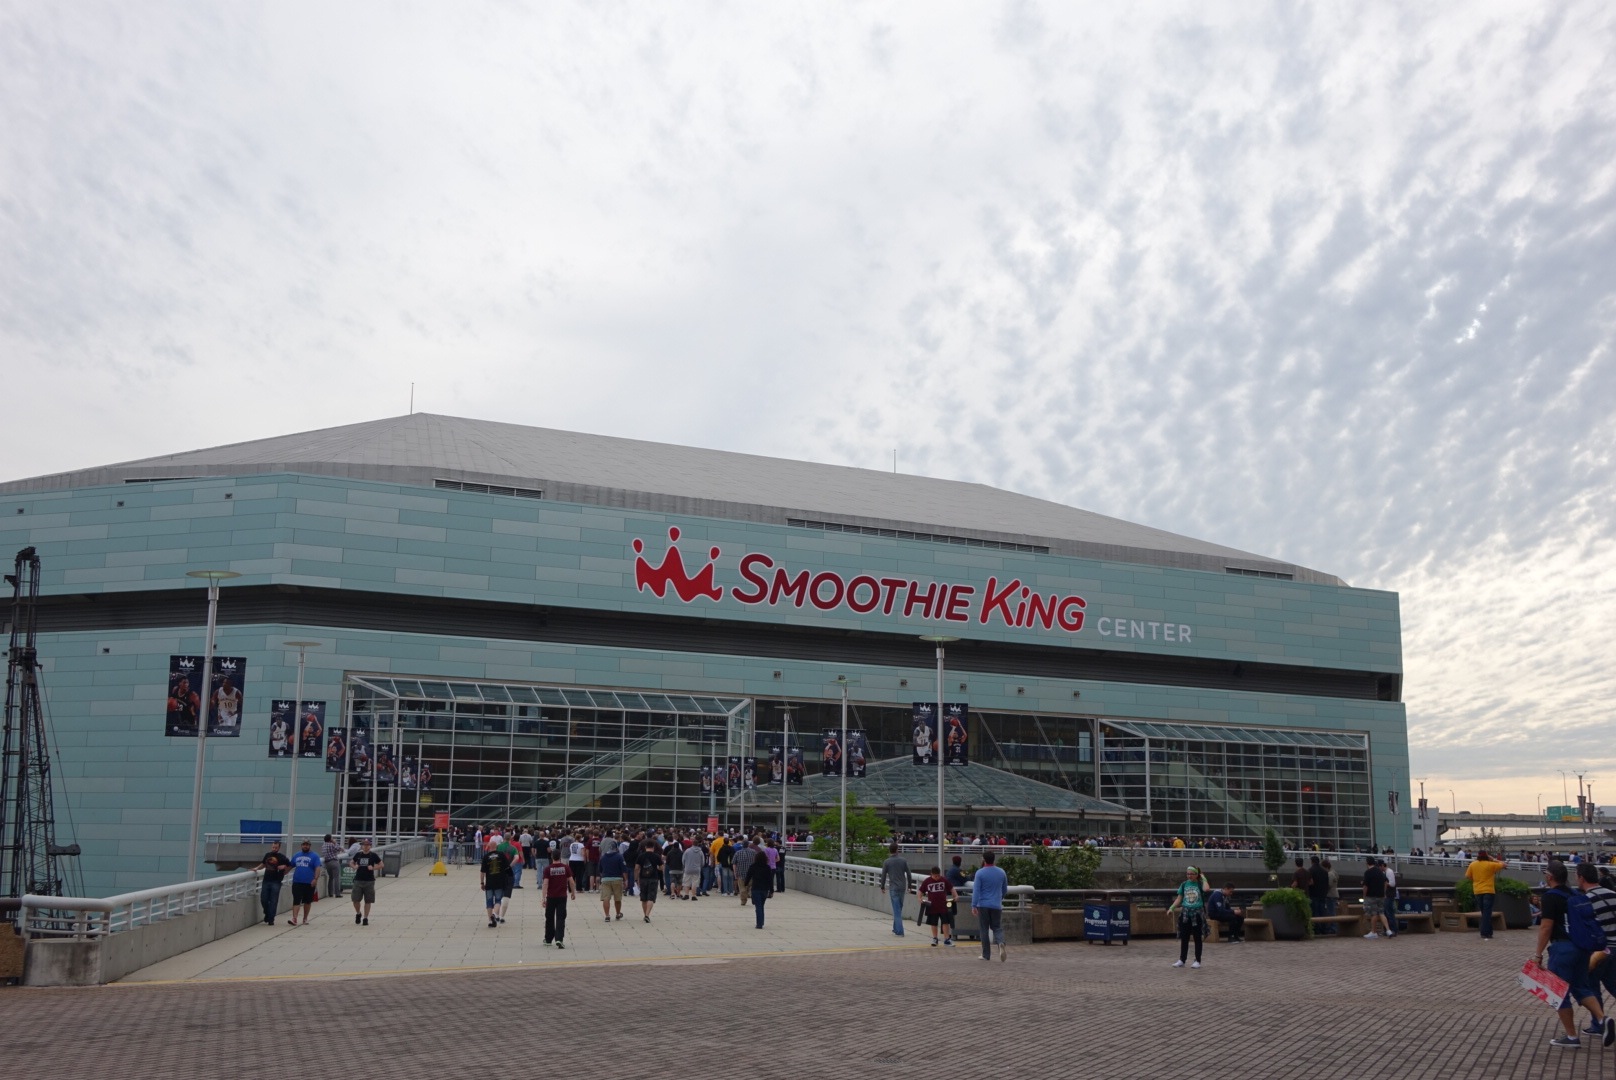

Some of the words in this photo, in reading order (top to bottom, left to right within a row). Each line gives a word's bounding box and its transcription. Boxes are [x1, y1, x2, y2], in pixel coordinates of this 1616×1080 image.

[731, 552, 976, 623] SMOOTHIE
[1097, 616, 1192, 644] CENTER
[928, 883, 944, 891] YES
